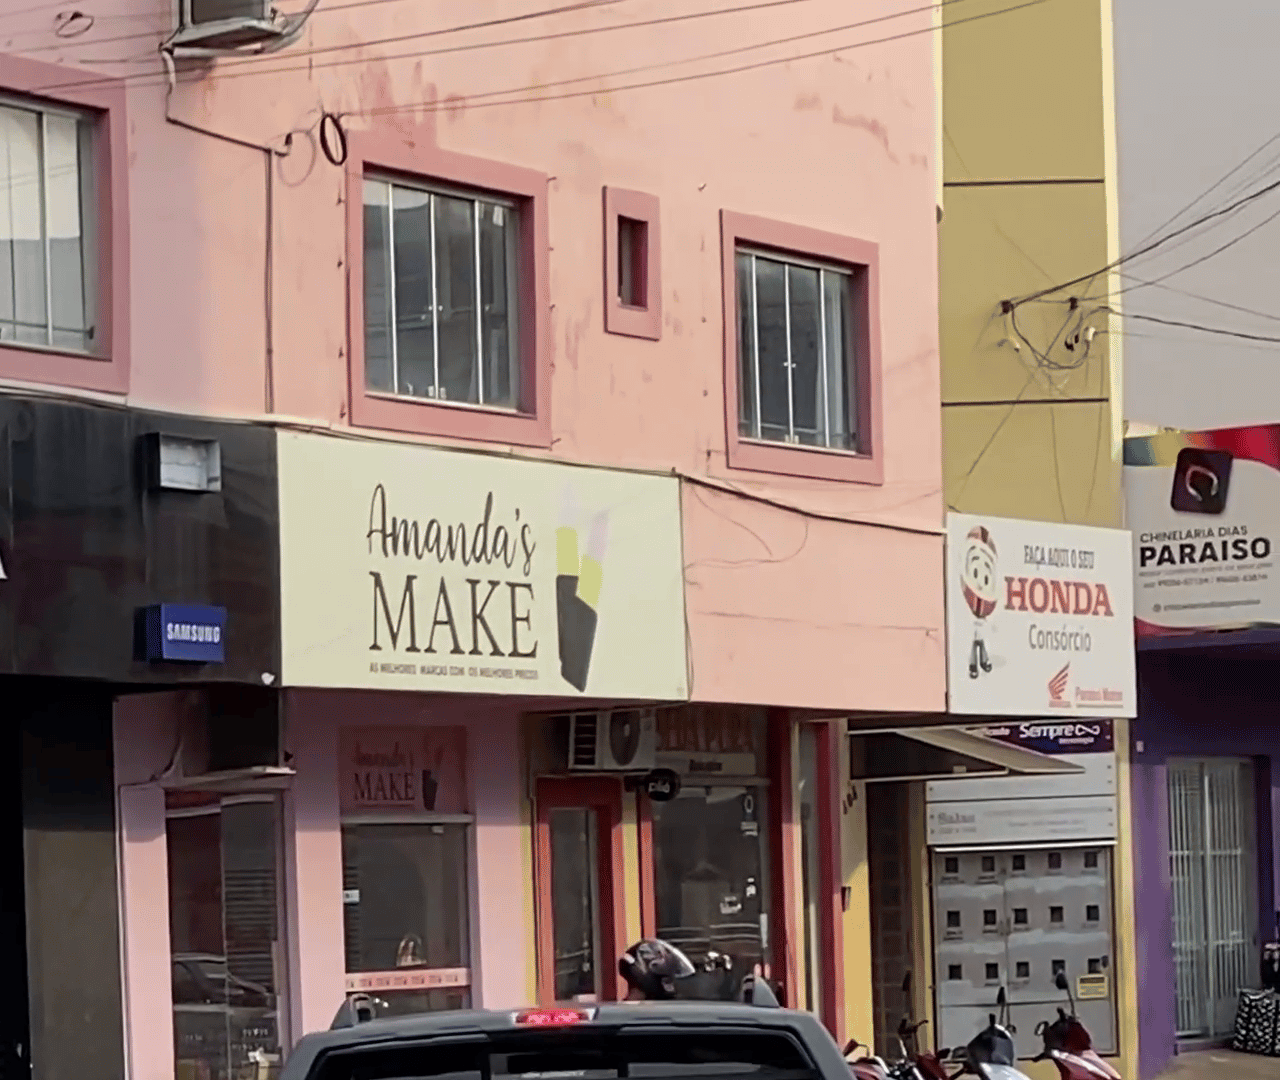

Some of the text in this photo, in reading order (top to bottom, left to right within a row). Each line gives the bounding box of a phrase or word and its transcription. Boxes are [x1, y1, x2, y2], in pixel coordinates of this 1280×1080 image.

[366, 483, 537, 577] Amanda's
[1140, 525, 1248, 543] CHINELARIA DIAS
[1078, 550, 1095, 569] SEU
[1139, 536, 1271, 568] PARAISO
[1004, 575, 1115, 617] HONDA
[368, 570, 539, 659] MAKE
[166, 621, 221, 643] SAMSUNG
[1028, 623, 1092, 652] Consórcio
[1019, 722, 1075, 740] Sempre
[354, 772, 416, 801] MAKE
